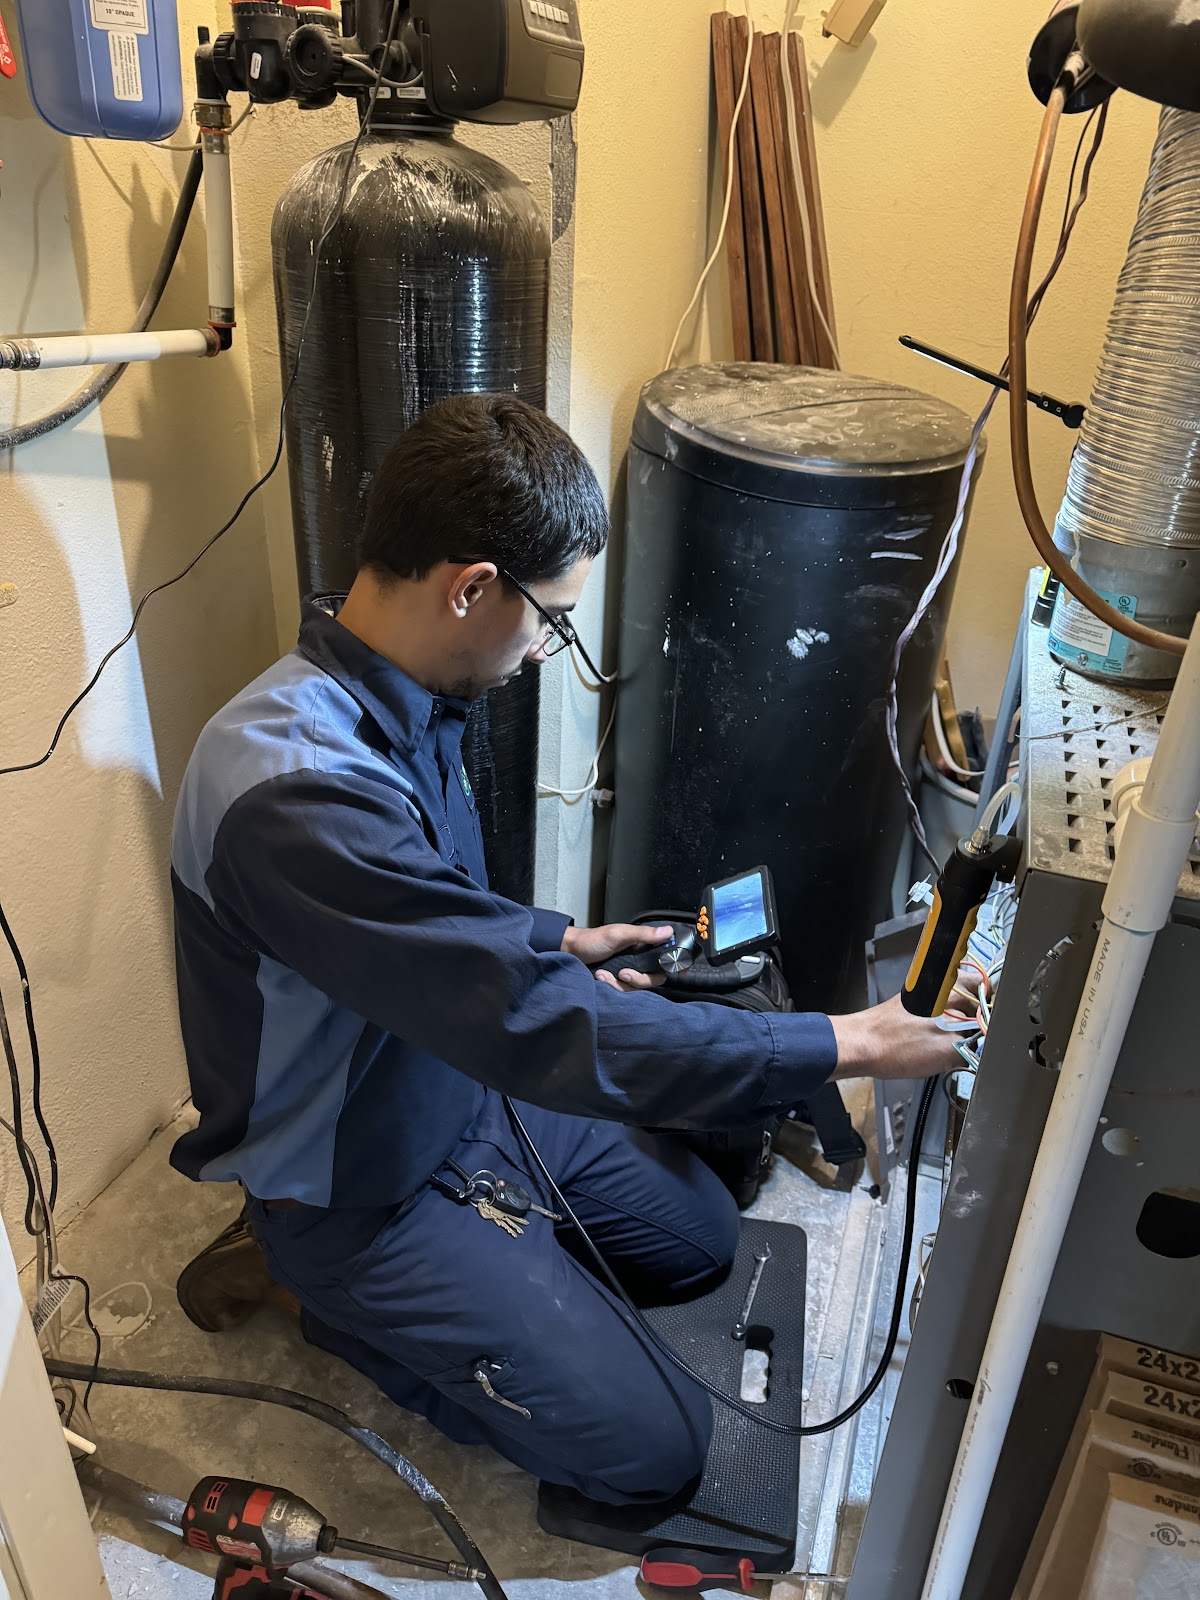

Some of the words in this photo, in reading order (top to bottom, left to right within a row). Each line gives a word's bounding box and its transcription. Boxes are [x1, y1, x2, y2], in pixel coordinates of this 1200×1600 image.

[1094, 938, 1111, 982] MADE
[1088, 987, 1096, 1002] IN
[1078, 1007, 1091, 1035] USA
[1131, 1430, 1189, 1460] Flanders
